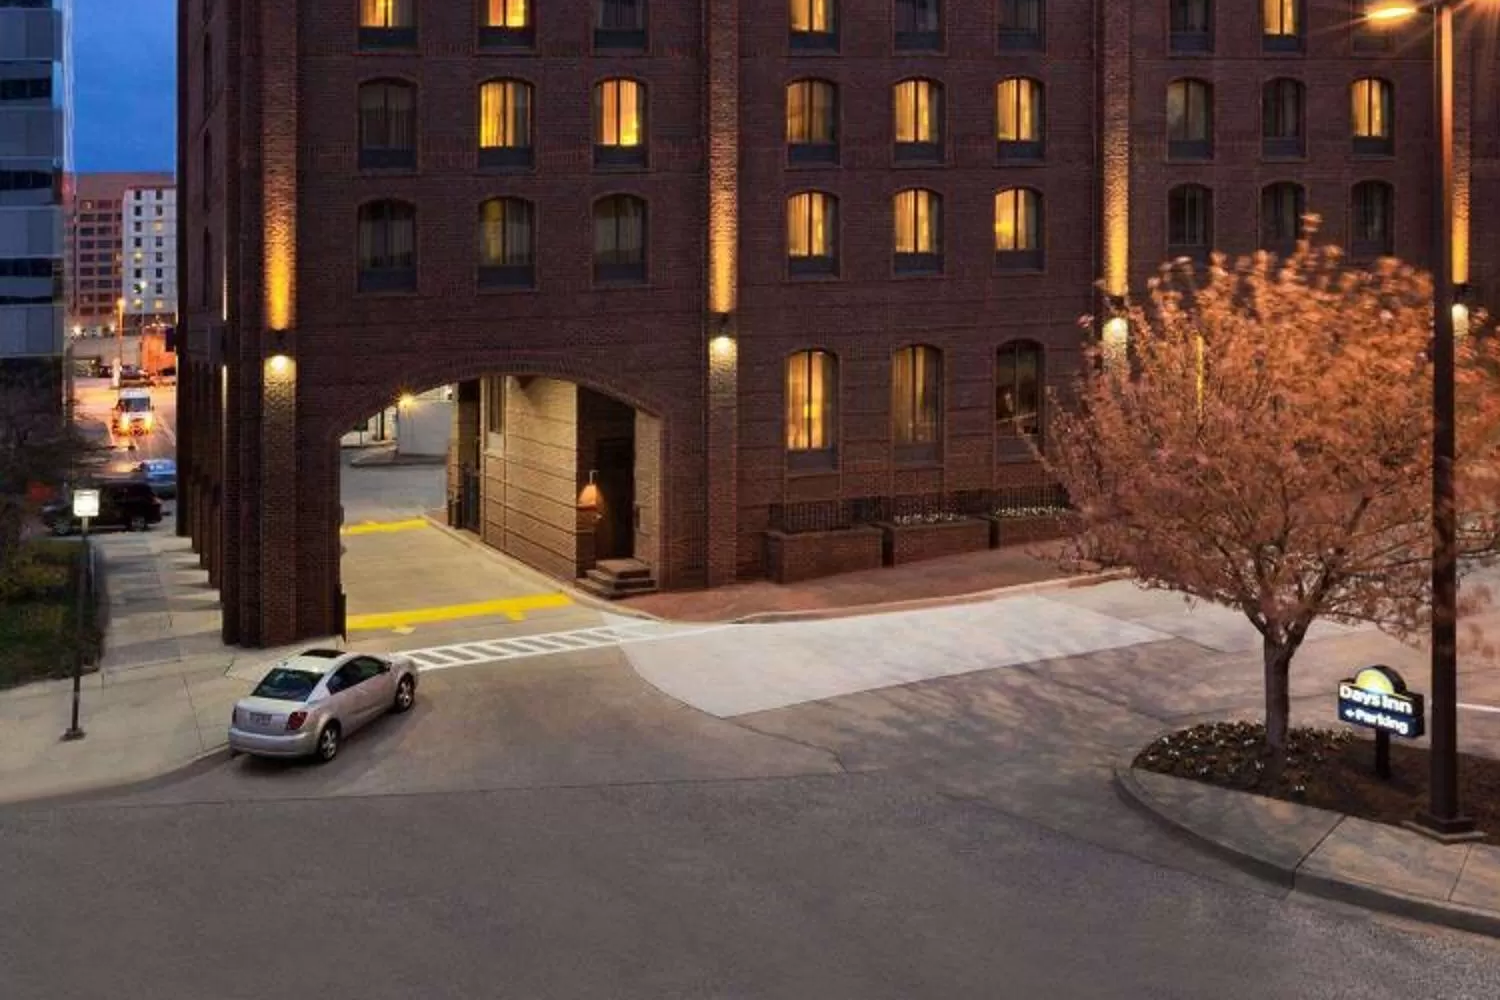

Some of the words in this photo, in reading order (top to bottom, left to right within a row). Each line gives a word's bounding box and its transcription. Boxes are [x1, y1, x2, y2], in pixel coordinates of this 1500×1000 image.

[1339, 684, 1380, 706] Days
[1382, 694, 1413, 714] Inn
[1355, 708, 1409, 735] Parking
